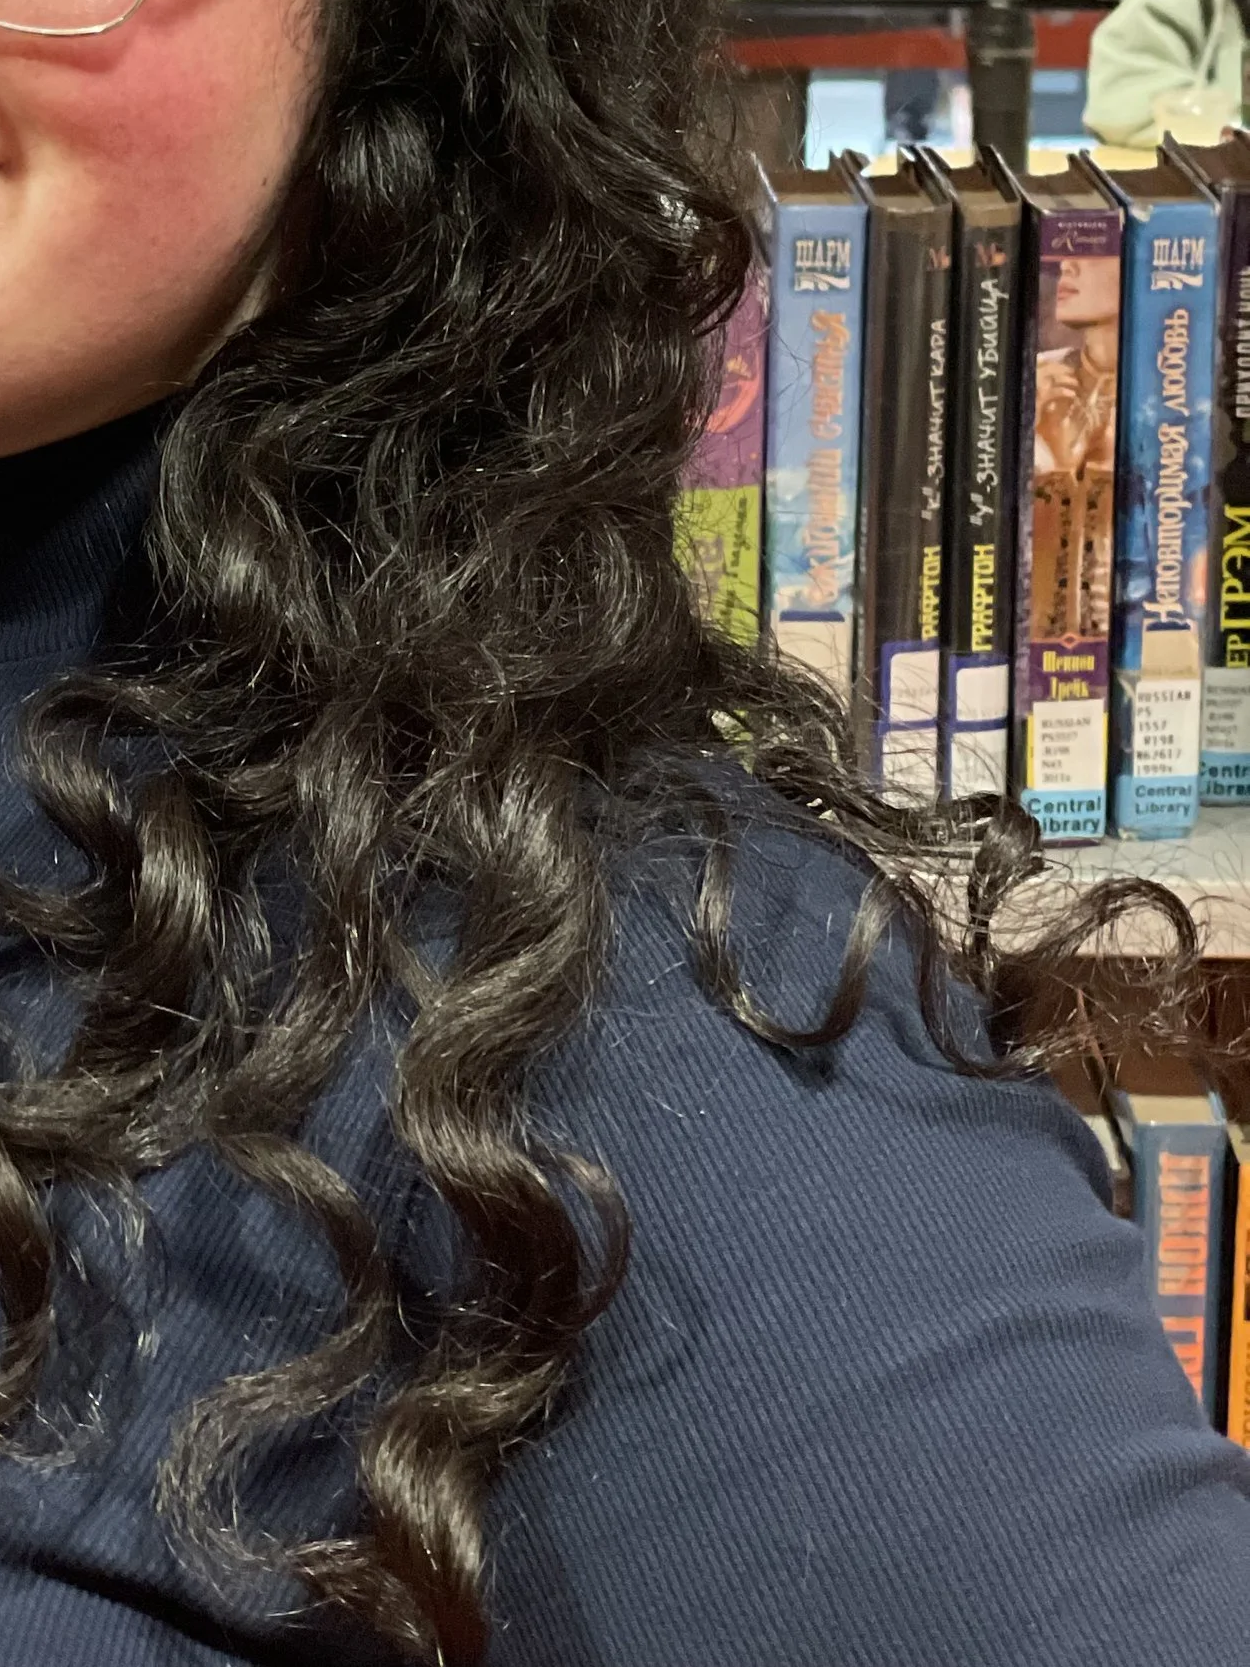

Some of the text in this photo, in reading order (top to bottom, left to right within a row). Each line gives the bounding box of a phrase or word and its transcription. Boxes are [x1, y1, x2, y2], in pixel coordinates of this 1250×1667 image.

[794, 239, 851, 269] ШАРМ
[1152, 238, 1207, 268] ШАРМ
[976, 279, 1011, 379] УБИЙЦА
[928, 318, 947, 377] КАРА
[1155, 308, 1193, 418] любовь
[1142, 423, 1194, 625] Неповторимая
[1219, 504, 1250, 630] ГРЭМ
[971, 543, 995, 652] ГРАФТОН
[1137, 690, 1192, 703] RUSSIAN
[1027, 796, 1101, 814] Central
[1134, 784, 1192, 798] Central
[1042, 815, 1100, 835] ibrary
[1135, 802, 1192, 818] Library
